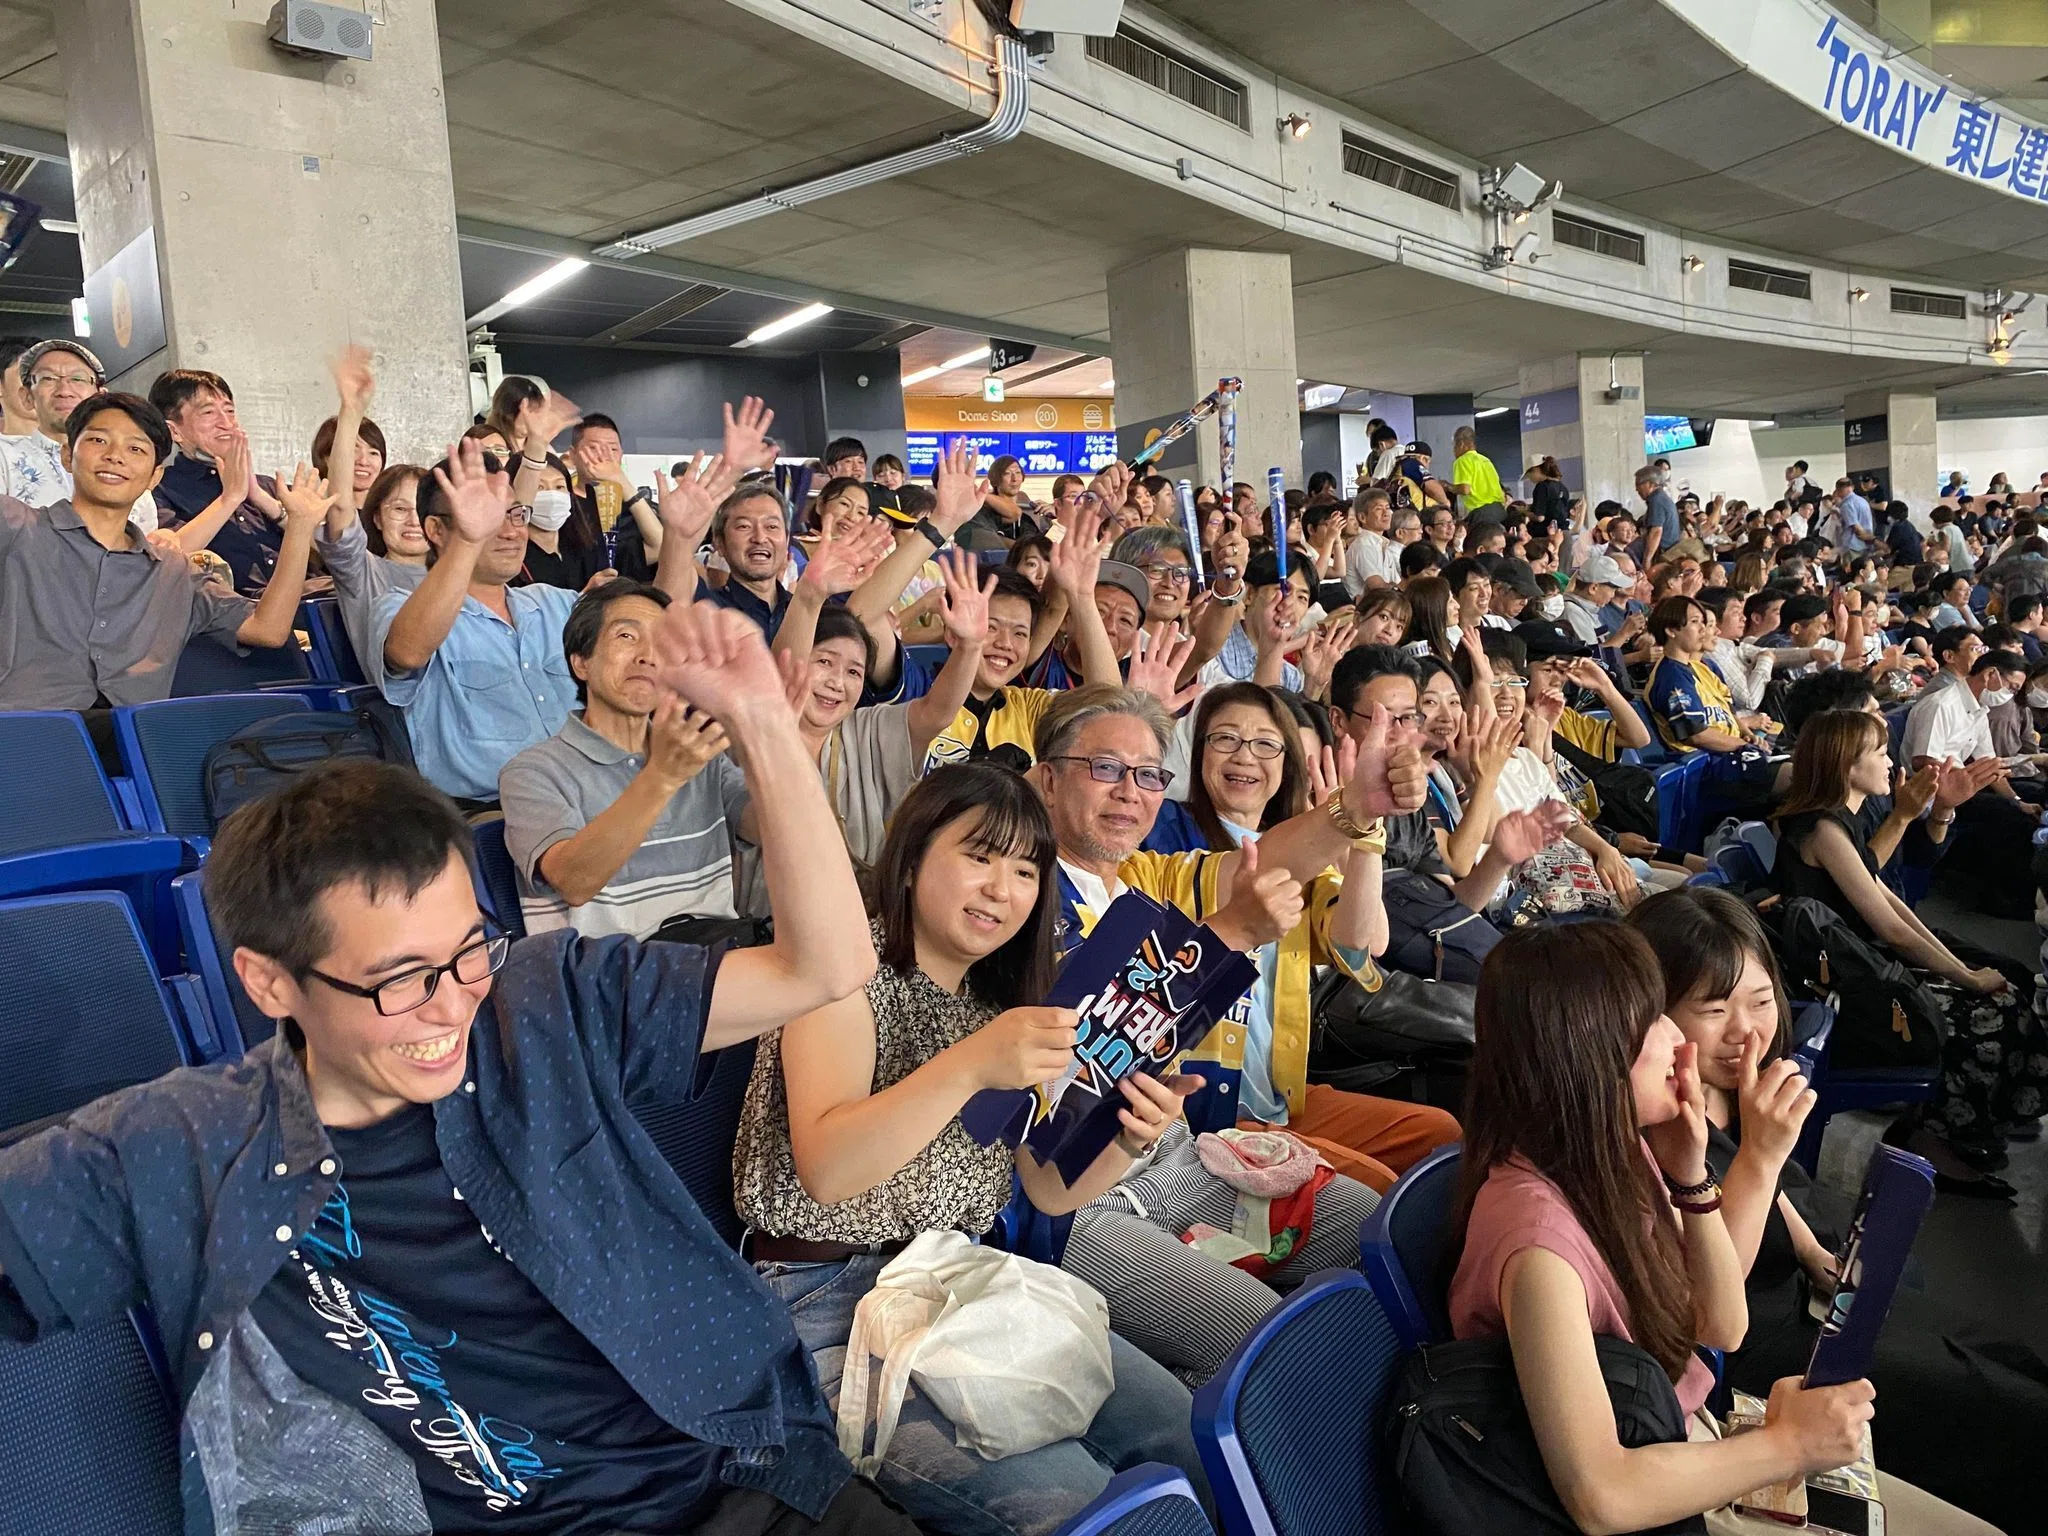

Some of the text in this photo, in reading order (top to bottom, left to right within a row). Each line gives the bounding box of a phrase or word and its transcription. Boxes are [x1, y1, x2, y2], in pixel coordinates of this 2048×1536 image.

[1946, 100, 2048, 201] 東レ建
[991, 349, 1006, 369] 43
[958, 410, 1018, 423] Dome Shop
[1039, 411, 1055, 422] 201
[1525, 402, 1540, 418] 44
[1849, 423, 1862, 435] 45
